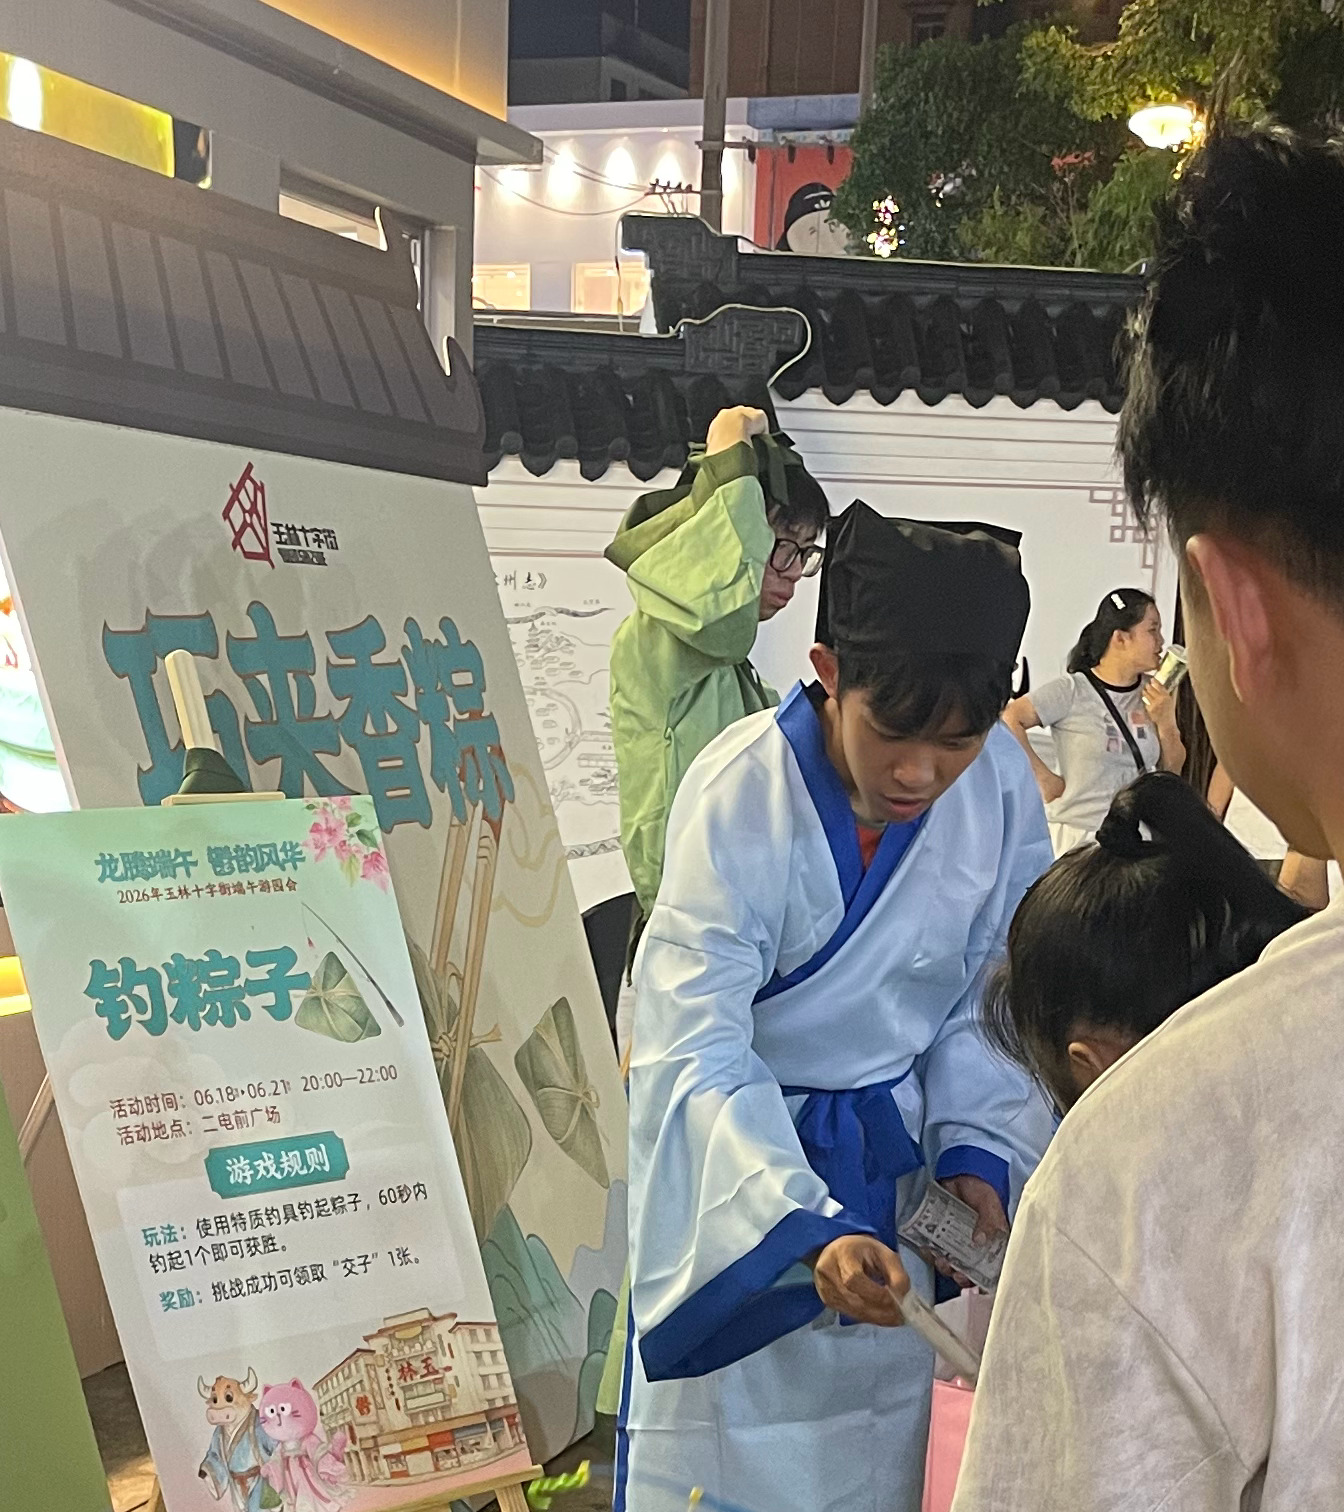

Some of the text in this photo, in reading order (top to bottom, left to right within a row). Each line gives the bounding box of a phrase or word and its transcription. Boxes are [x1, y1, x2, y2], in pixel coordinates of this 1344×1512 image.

[270, 522, 338, 550] 玉林十字街
[494, 571, 547, 590] 州志》
[83, 945, 312, 1041] 钓粽子
[202, 1105, 282, 1134] 二电前广场
[225, 1143, 331, 1186] 游戏规则
[149, 1233, 288, 1275] 钓起1个即可获胜。
